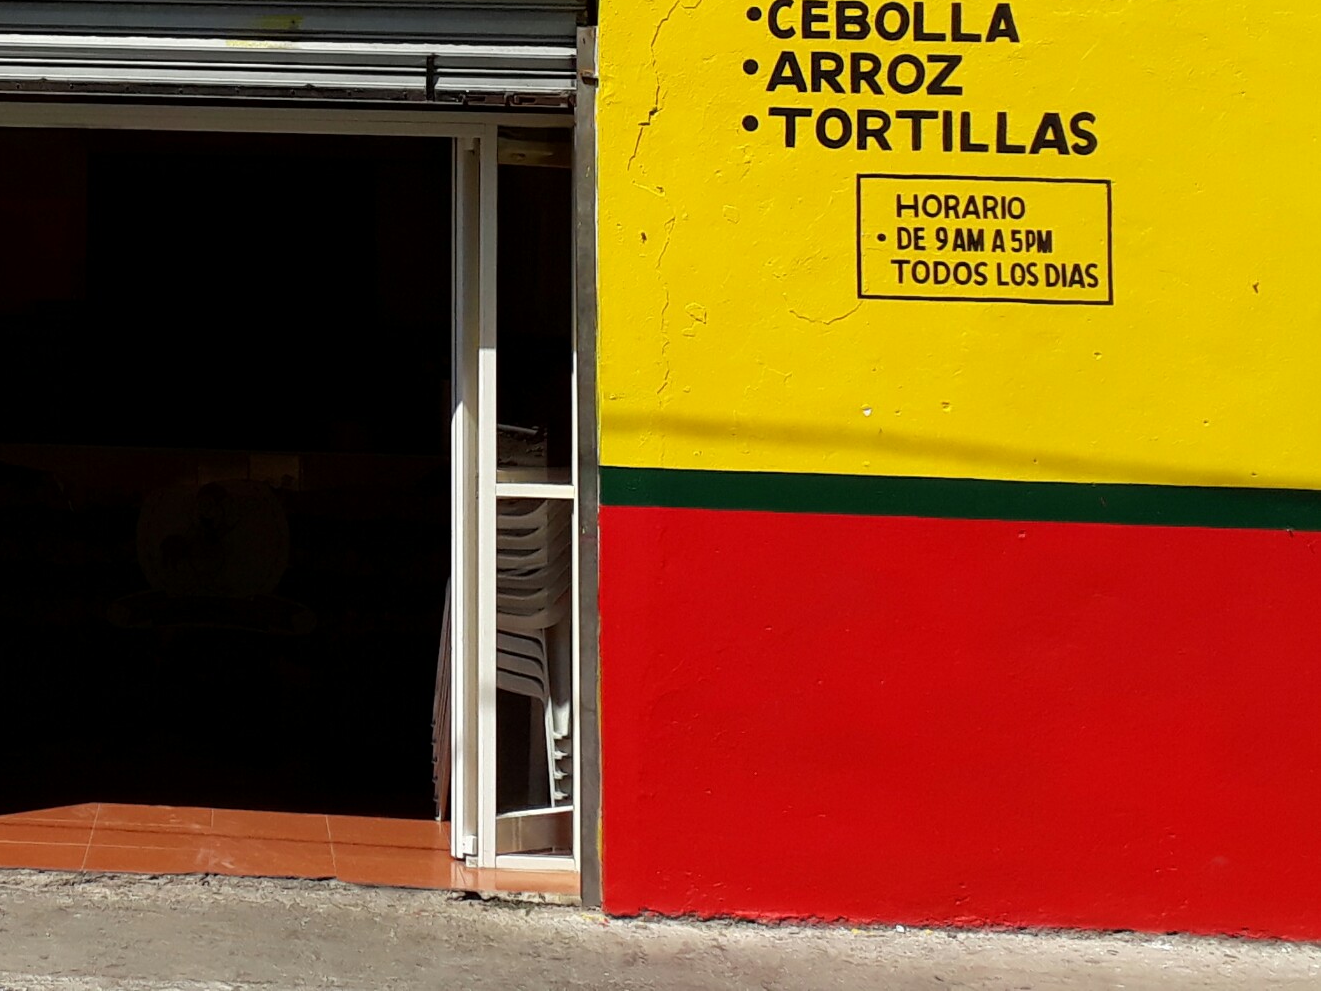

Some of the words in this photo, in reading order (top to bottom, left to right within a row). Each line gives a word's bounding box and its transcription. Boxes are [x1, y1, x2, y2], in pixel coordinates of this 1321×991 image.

[765, 50, 964, 96] ARROZ
[768, 106, 1099, 156] TORTILLAS
[895, 193, 1026, 220] HORARIO
[896, 226, 926, 251] DE
[991, 228, 1006, 253] A
[890, 259, 988, 286] TODOS
[996, 262, 1039, 287] LOS
[1044, 262, 1099, 289] DIAS
